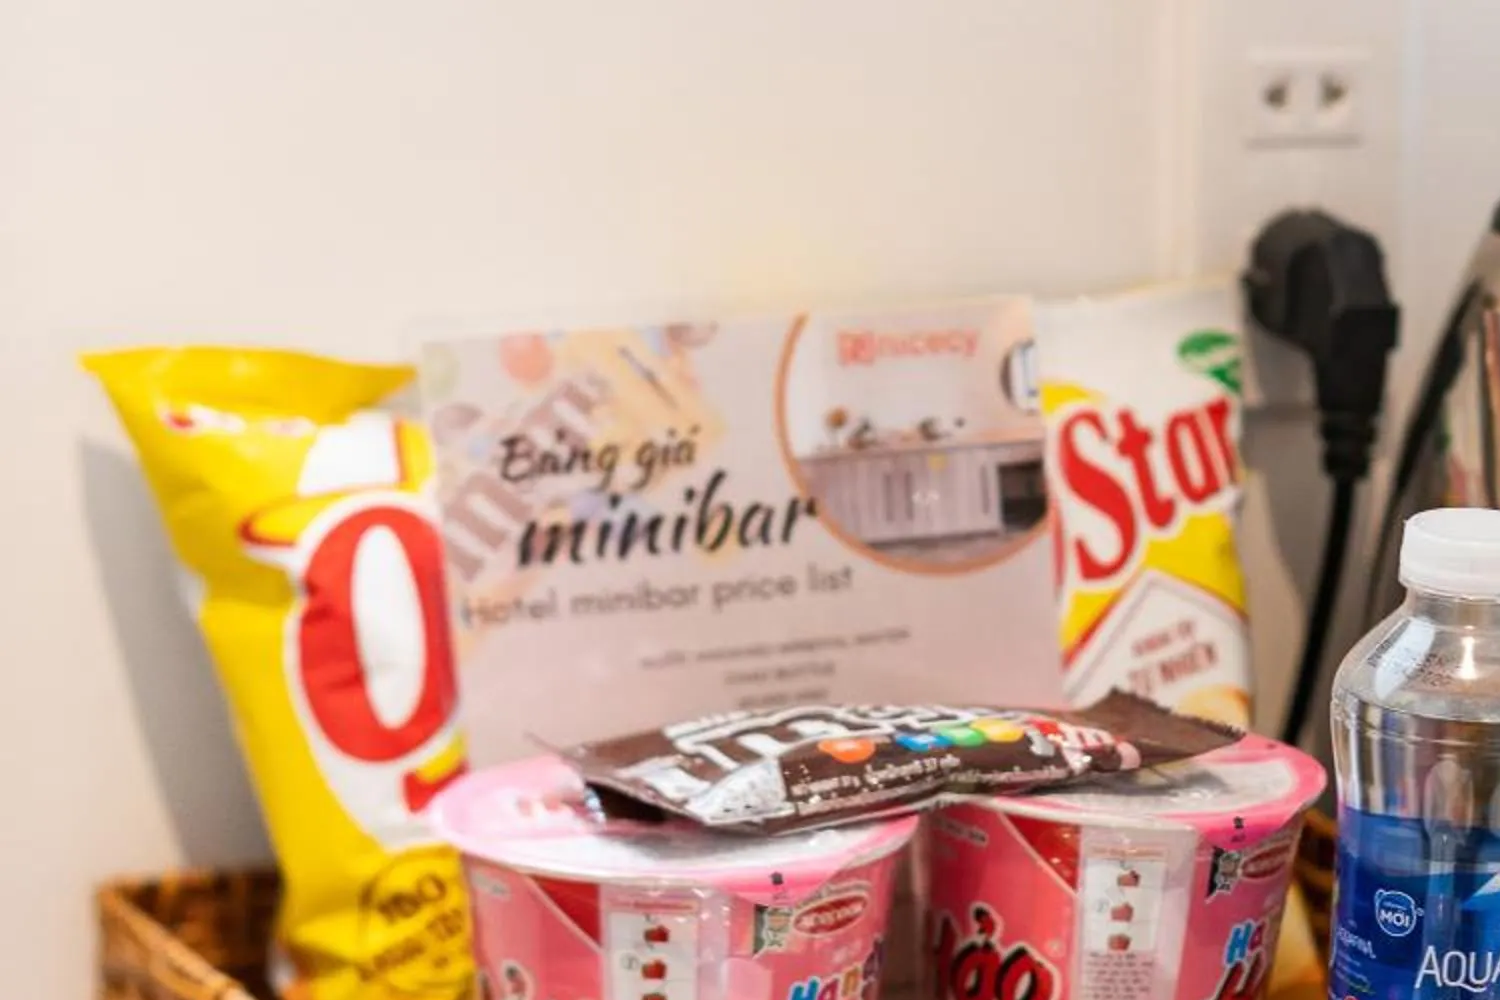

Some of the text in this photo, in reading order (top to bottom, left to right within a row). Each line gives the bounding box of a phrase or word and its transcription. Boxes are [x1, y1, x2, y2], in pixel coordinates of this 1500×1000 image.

[516, 469, 818, 567] minibar
[463, 563, 855, 628] Hotel minibar price list
